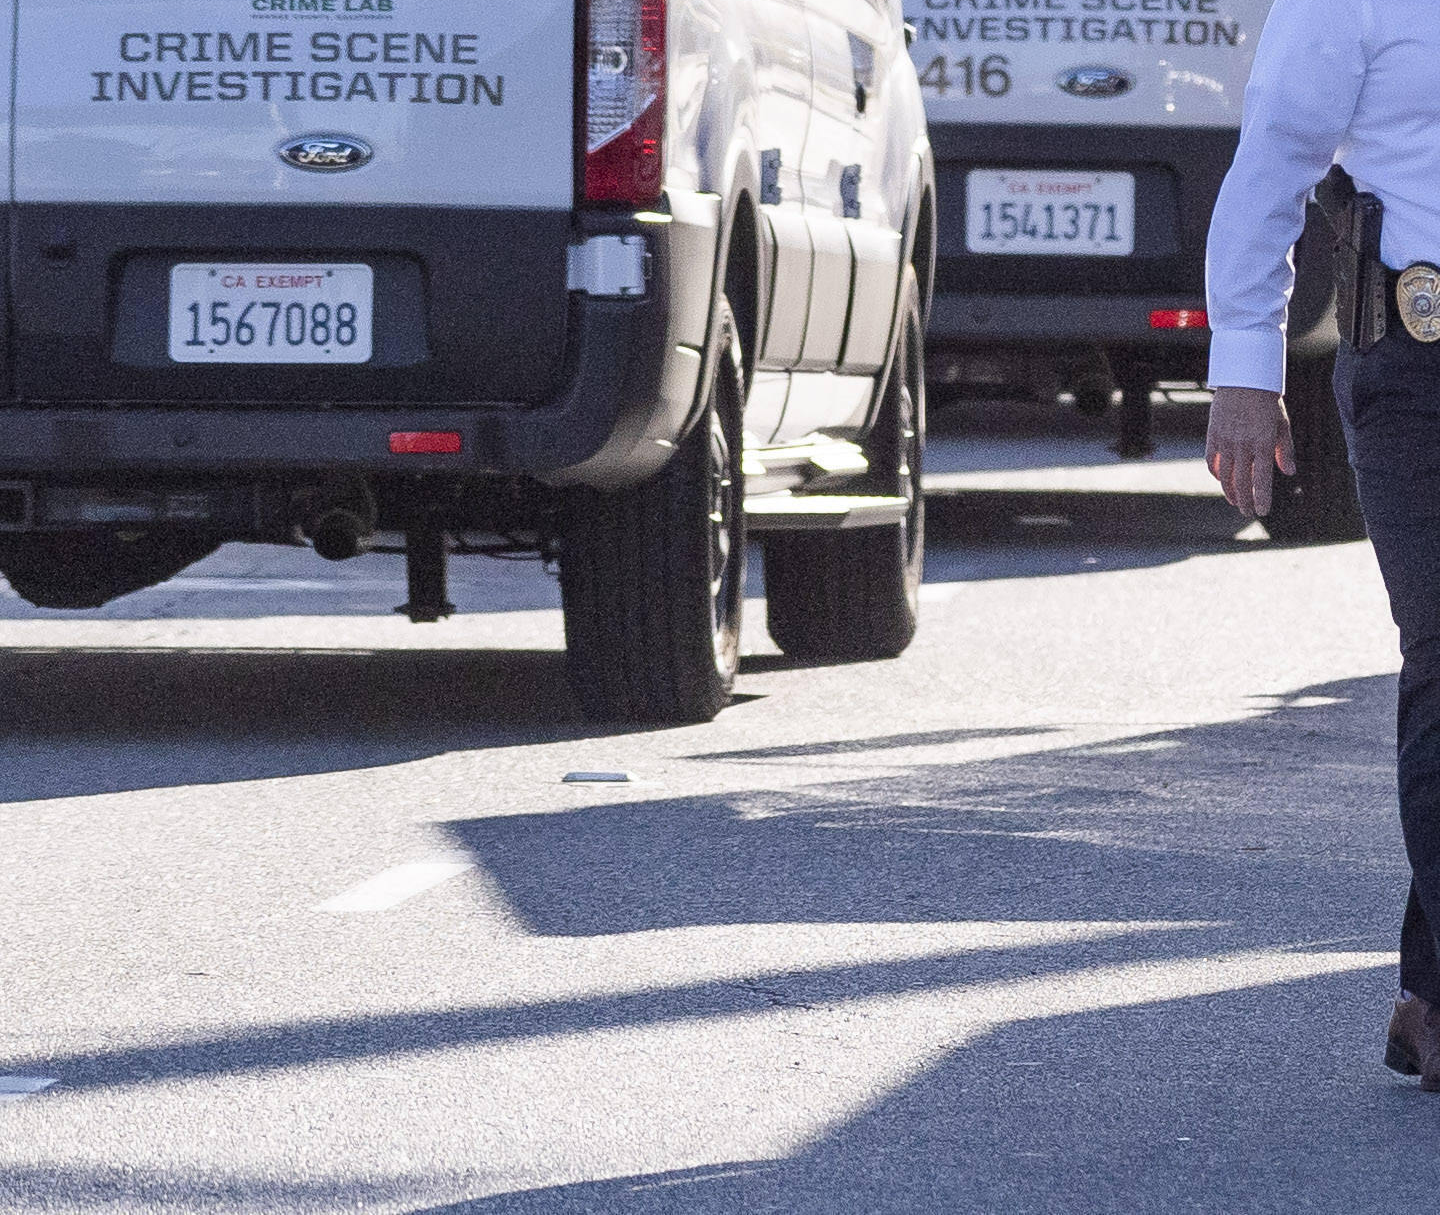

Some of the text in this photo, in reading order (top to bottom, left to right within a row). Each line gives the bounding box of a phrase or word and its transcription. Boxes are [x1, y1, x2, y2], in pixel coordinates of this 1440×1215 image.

[119, 32, 479, 64] CRIME SCENE
[91, 71, 505, 106] INVESTIGATION
[918, 54, 1011, 98] 416
[982, 202, 1120, 241] 1541371
[221, 275, 324, 289] CA EXEMPT
[185, 301, 357, 346] 1567088
